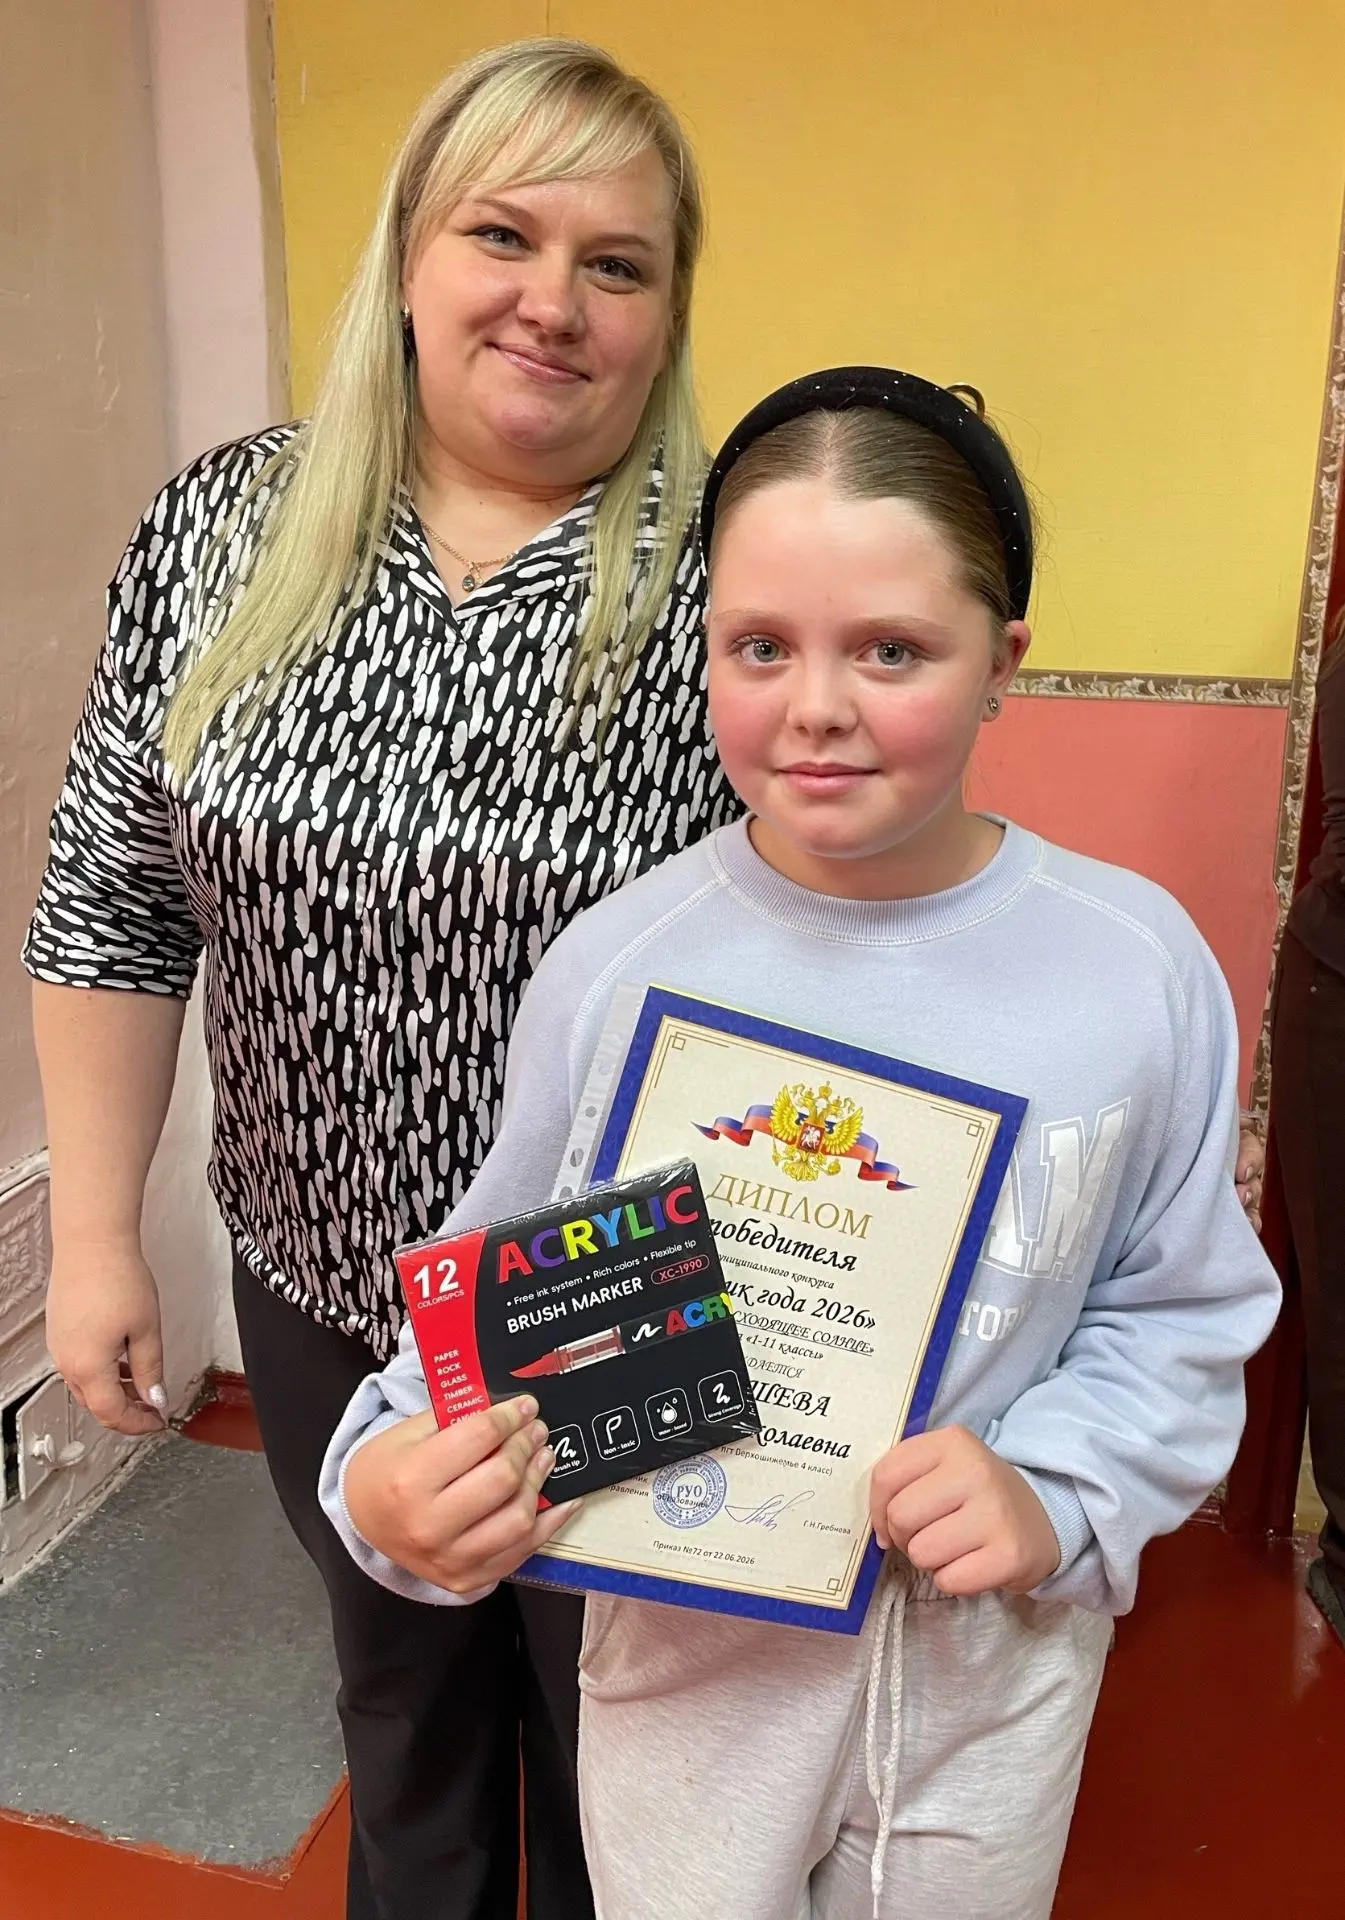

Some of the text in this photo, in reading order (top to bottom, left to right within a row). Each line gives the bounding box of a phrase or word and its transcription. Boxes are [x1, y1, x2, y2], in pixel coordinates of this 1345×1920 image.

[704, 1173, 873, 1240] ДИПЛОМ
[496, 1184, 699, 1284] ACRYLIC
[709, 1217, 858, 1272] победителя
[413, 1258, 459, 1299] 12
[513, 1239, 697, 1305] Free ink system Rich colors Flexible tip
[658, 1258, 703, 1282] XC-1990
[719, 1253, 835, 1290] униципального конкурса
[417, 1289, 465, 1309] COLORS/PCS
[506, 1276, 644, 1334] BRUSH MARKER
[725, 1280, 876, 1330] ик года 2026»
[734, 1310, 811, 1338] СХОДЯЩЕЕ
[434, 1349, 459, 1363] PAPER
[746, 1333, 778, 1349] «1-11
[779, 1342, 824, 1360] классы»
[437, 1362, 461, 1376] ROCK
[745, 1354, 806, 1379] ДАЕТСЯ
[440, 1373, 468, 1388] GLASS
[443, 1385, 473, 1400] TIMBER
[447, 1395, 485, 1414] CERAMIC
[750, 1379, 831, 1417] ШЕВА
[800, 1461, 807, 1470] 4
[807, 1464, 833, 1477] класс)
[609, 1484, 649, 1497] равления
[676, 1484, 703, 1498] РУО
[653, 1540, 681, 1552] Приказ
[683, 1545, 702, 1556] №72
[703, 1550, 713, 1558] от
